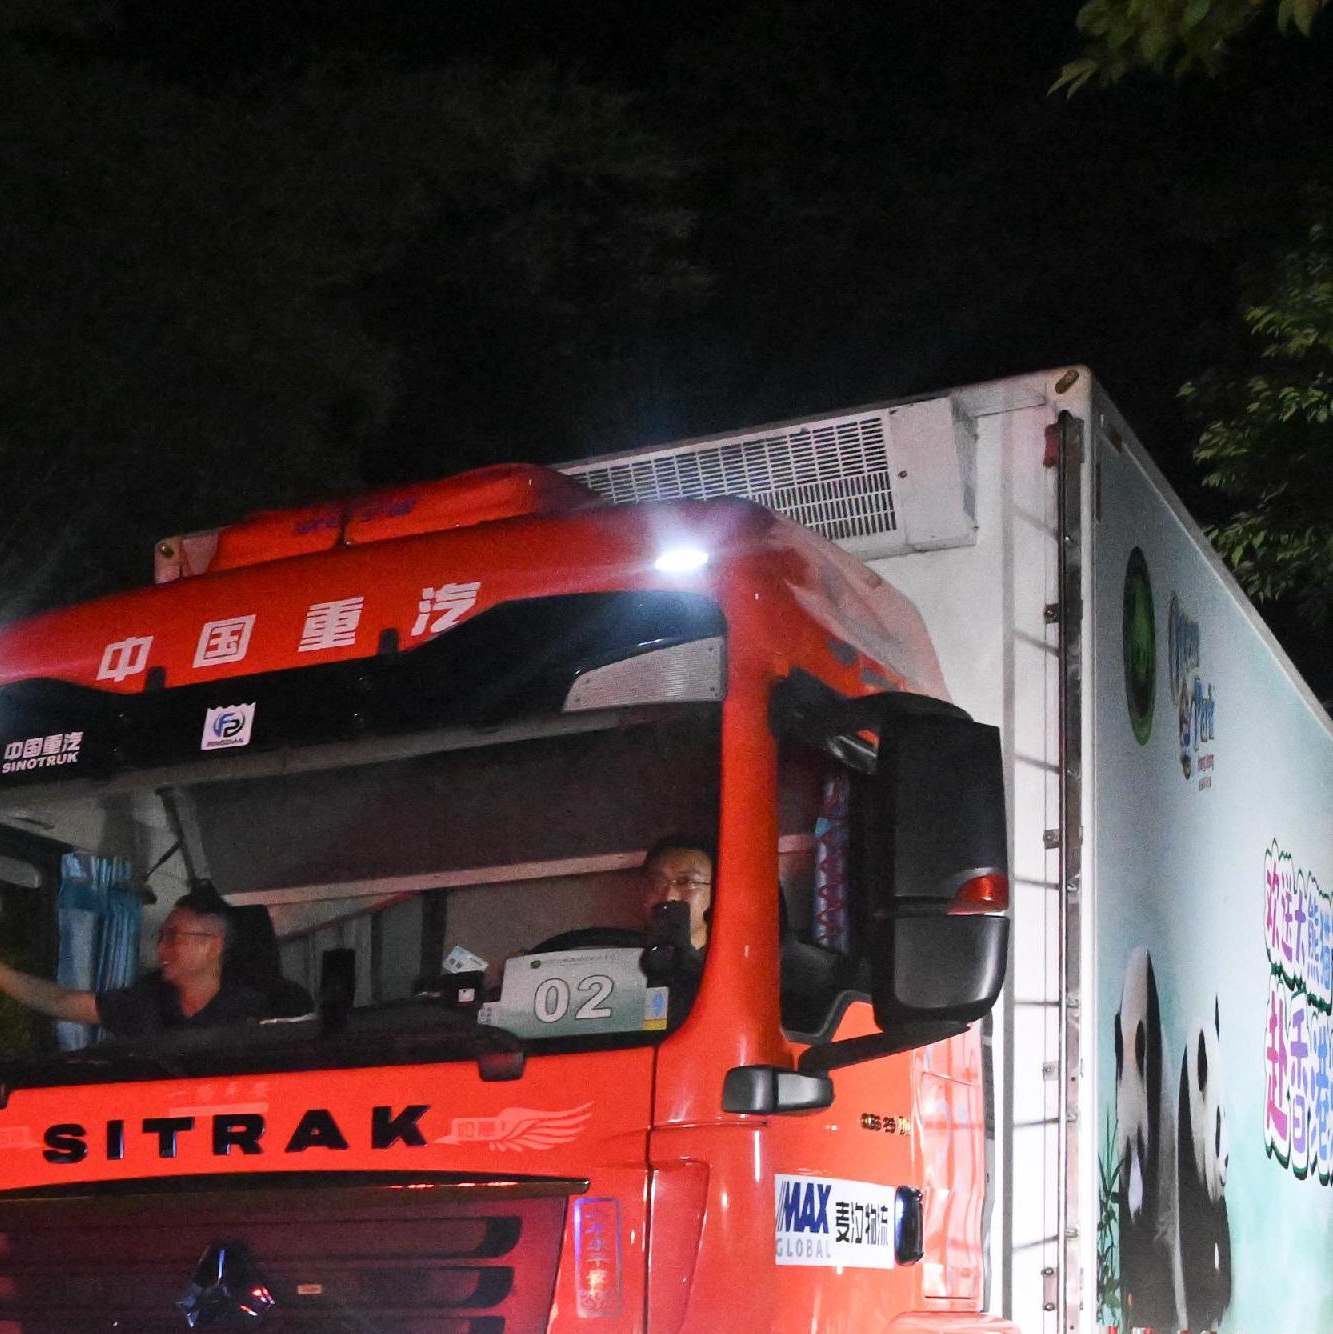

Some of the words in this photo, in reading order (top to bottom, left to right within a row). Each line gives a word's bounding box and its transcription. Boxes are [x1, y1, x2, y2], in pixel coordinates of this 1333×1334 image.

[96, 582, 482, 683] 中国重汽
[2, 751, 78, 774] SINOTRUK
[4, 731, 84, 761] 中国重汽
[534, 974, 615, 1023] 02
[42, 1104, 432, 1164] SITRAK
[779, 1181, 832, 1234] MAX
[776, 1238, 831, 1258] GLOBAL
